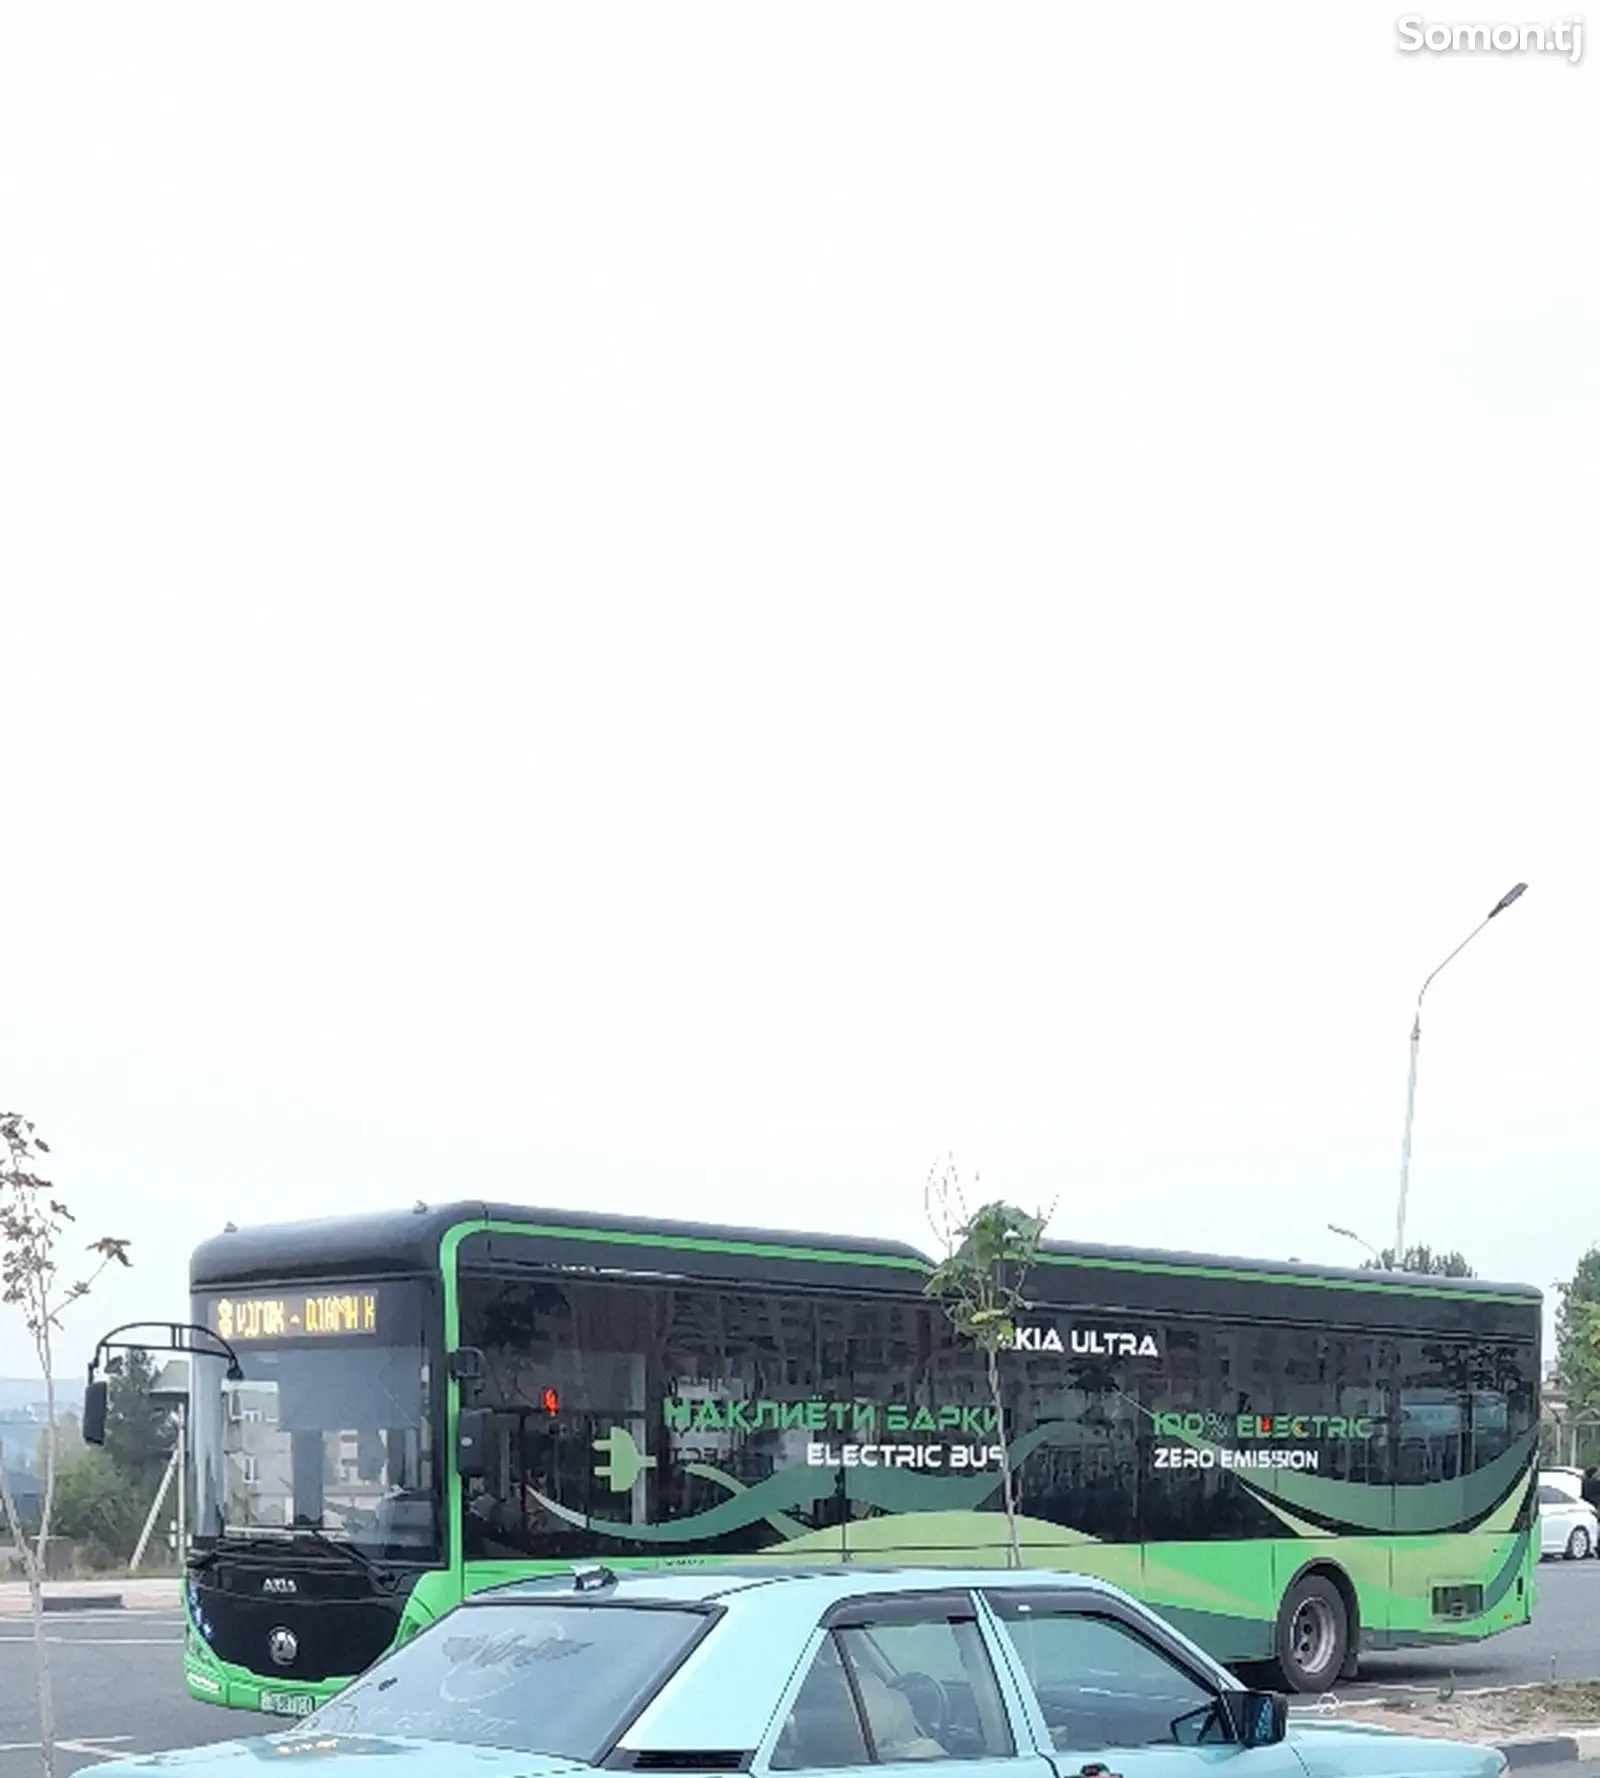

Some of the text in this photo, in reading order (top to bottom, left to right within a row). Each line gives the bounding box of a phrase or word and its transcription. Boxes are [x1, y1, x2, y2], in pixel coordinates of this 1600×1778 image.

[1071, 1330, 1159, 1357] ULTRA
[1153, 1409, 1376, 1439] 100% ELECTRIC
[806, 1442, 943, 1468] ELECTRIC
[1153, 1447, 1320, 1470] ZERO EMISSION
